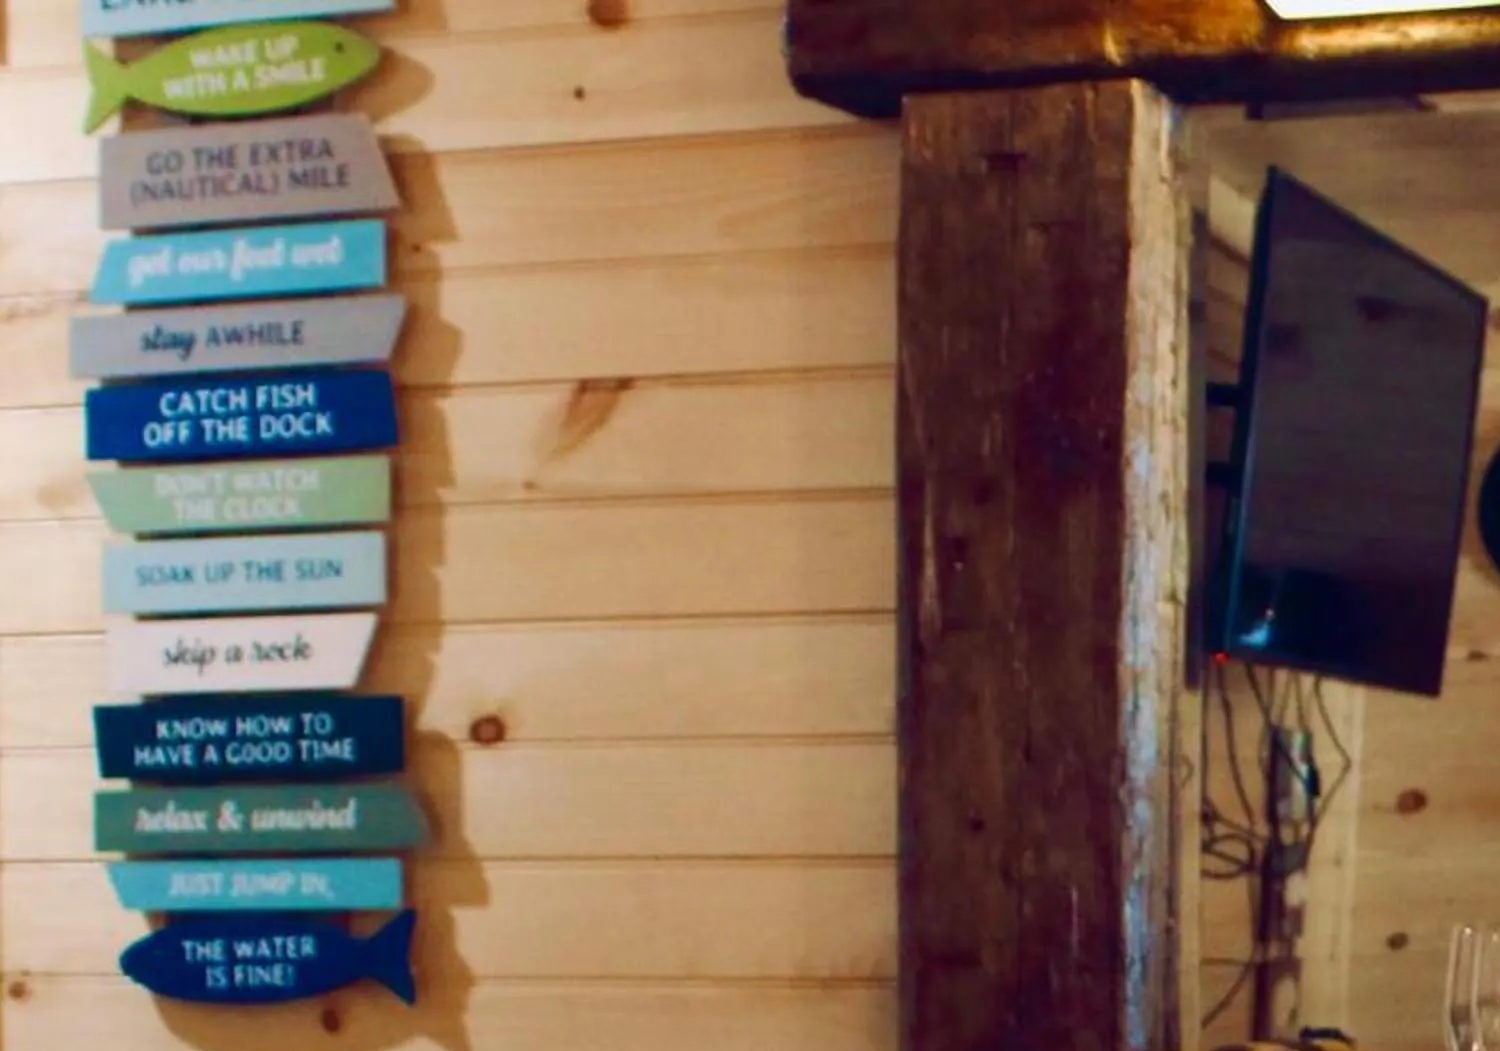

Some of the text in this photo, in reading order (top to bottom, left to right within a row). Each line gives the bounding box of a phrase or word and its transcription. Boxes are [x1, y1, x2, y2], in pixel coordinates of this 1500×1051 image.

[190, 36, 299, 67] WAKE UP
[161, 59, 326, 97] WITH A SMILE
[146, 139, 335, 175] GO THE EXTRA
[130, 163, 350, 202] (NAUTICAL) MILE
[140, 320, 306, 361] stay AWHILE
[158, 383, 316, 417] CATCH FISH
[142, 411, 333, 447] OFF THE DOCK
[233, 467, 319, 491] WATCH
[172, 493, 300, 522] THE CLOCK
[135, 559, 342, 587] SOAK UP THE SUN
[162, 634, 216, 675] skip
[224, 647, 244, 664] a
[155, 711, 334, 741] KNOW HOW TO
[133, 737, 356, 767] HAVE A GOOD TIME
[135, 797, 357, 831] relax & unwind
[169, 872, 225, 898] JUST
[230, 872, 293, 897] JUMP
[181, 935, 316, 962] THE WATER
[206, 964, 296, 988] IS FINE!
